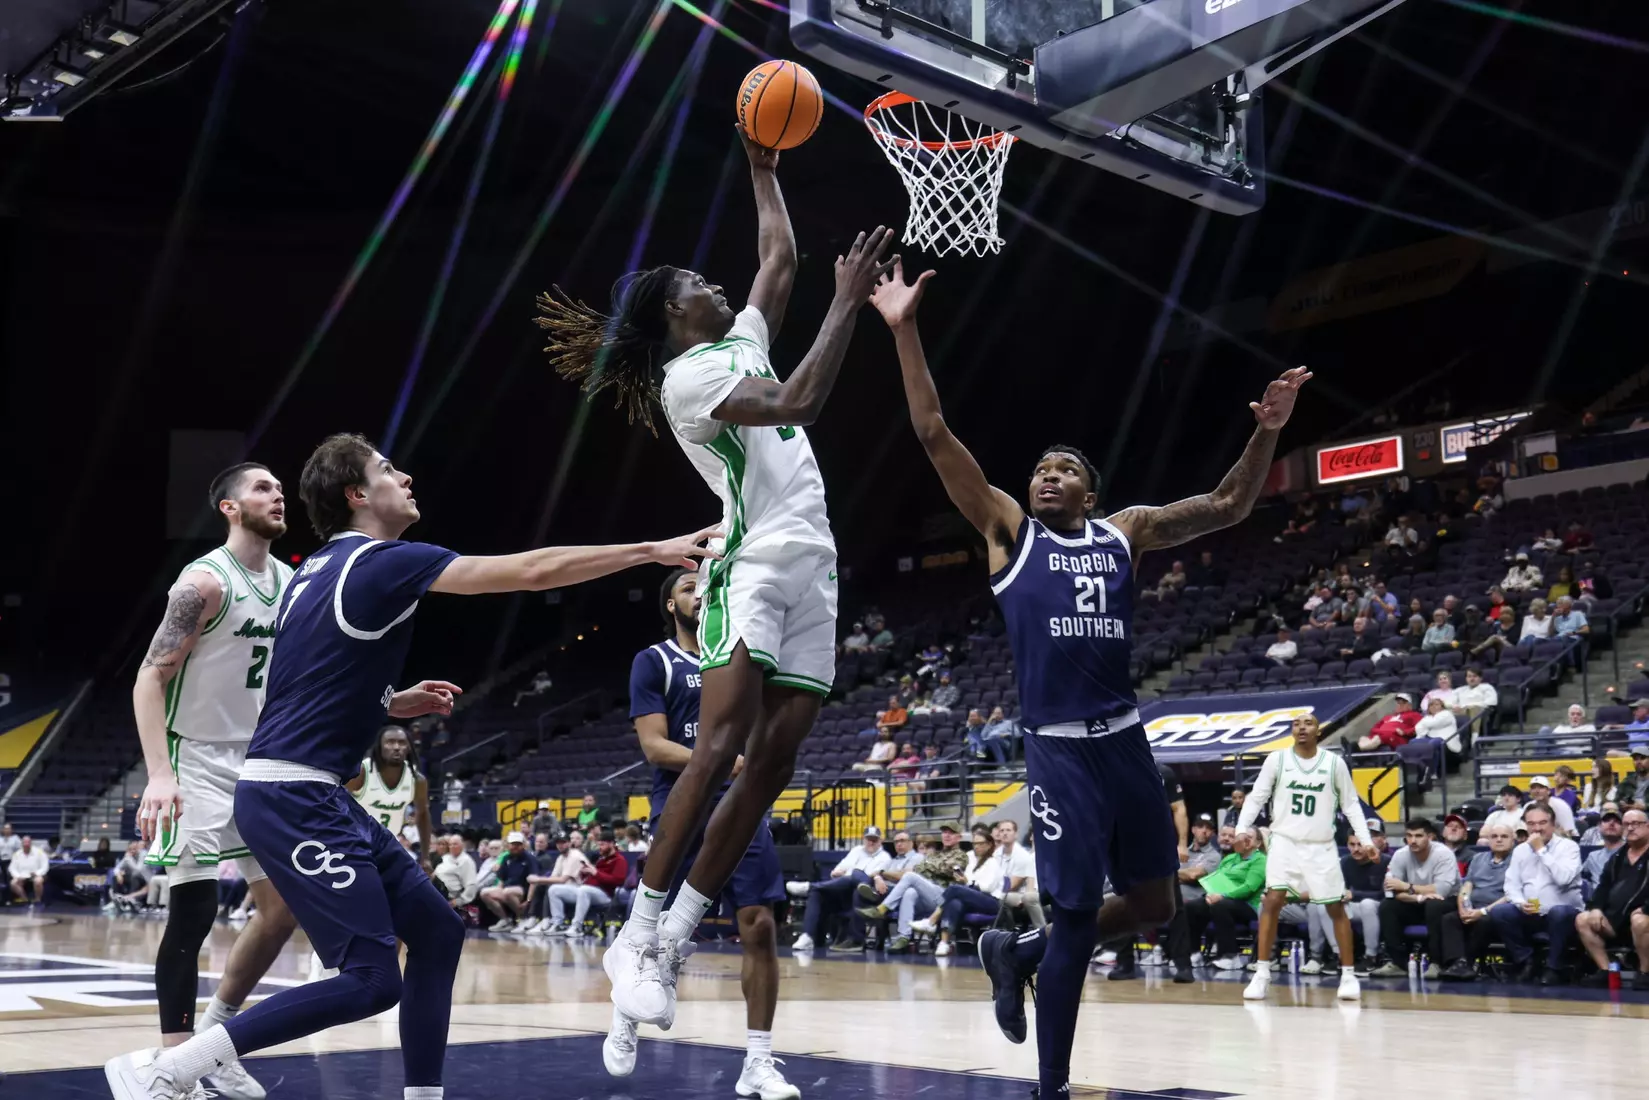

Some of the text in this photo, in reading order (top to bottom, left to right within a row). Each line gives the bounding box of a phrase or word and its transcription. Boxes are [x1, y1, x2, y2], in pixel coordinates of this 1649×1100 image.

[740, 72, 766, 127] Wilson
[1048, 553, 1118, 573] GEORGIA
[1074, 576, 1106, 613] 21
[1049, 617, 1124, 640] SOUTHERN
[246, 646, 268, 689] 2
[1030, 785, 1062, 841] GS
[1291, 793, 1316, 817] 50
[291, 840, 356, 889] GS
